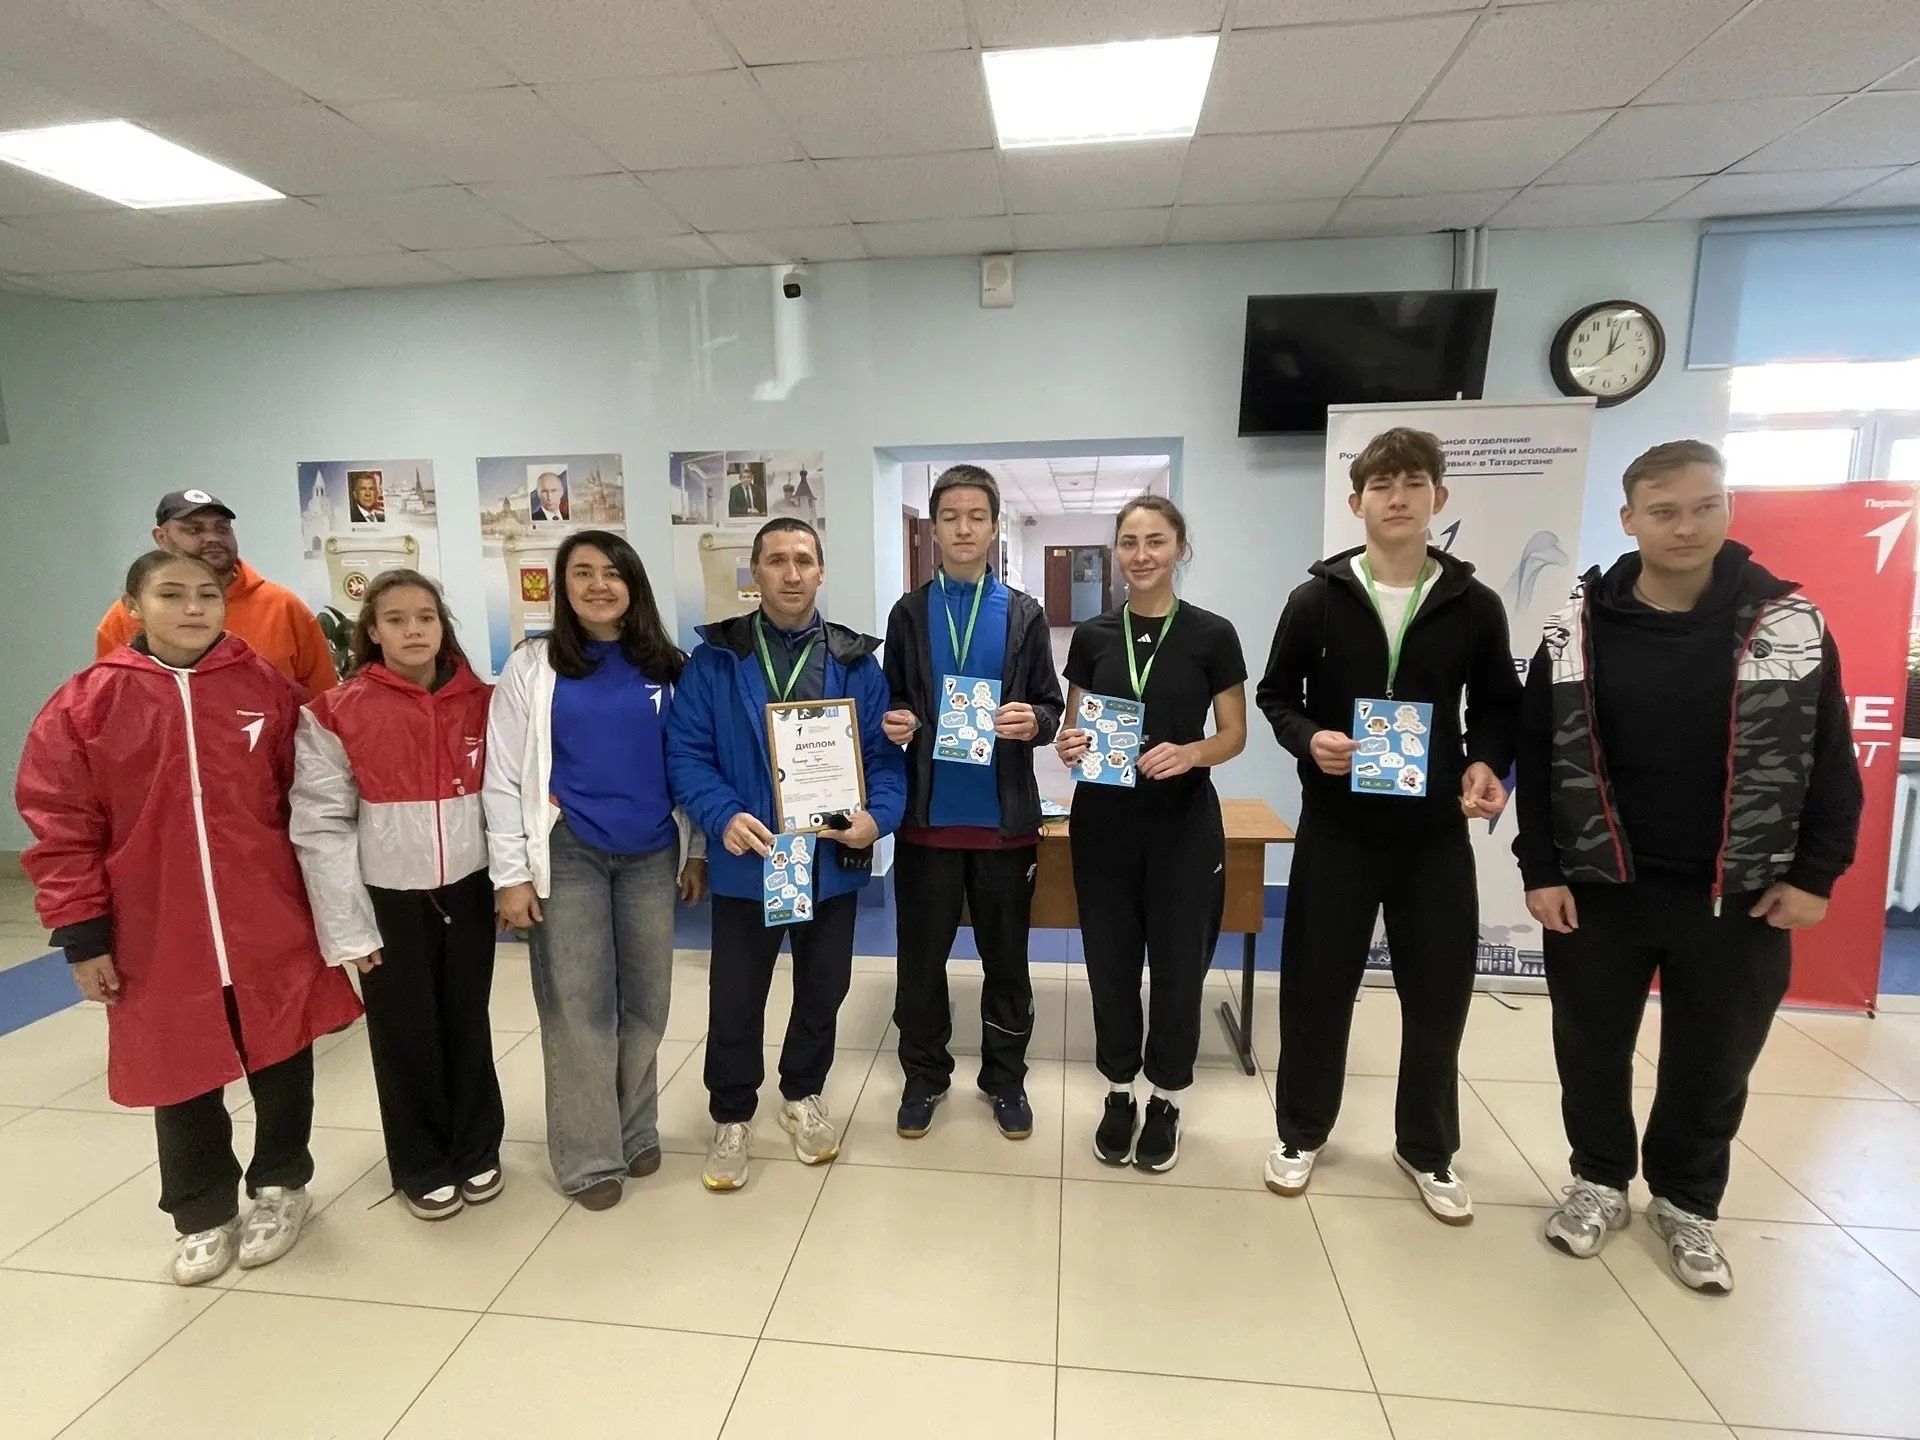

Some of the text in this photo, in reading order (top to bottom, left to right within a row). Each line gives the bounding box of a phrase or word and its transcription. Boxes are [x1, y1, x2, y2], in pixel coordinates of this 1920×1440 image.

[1592, 321, 1600, 331] 11
[1573, 348, 1582, 359] 9
[1588, 375, 1597, 386] 7
[1602, 379, 1611, 389] 6
[1468, 436, 1532, 446] отделение
[1471, 447, 1507, 456] детей
[1518, 446, 1578, 455] молодёжи
[1488, 458, 1554, 468] Татарстане
[795, 740, 836, 751] ДИПЛОМ
